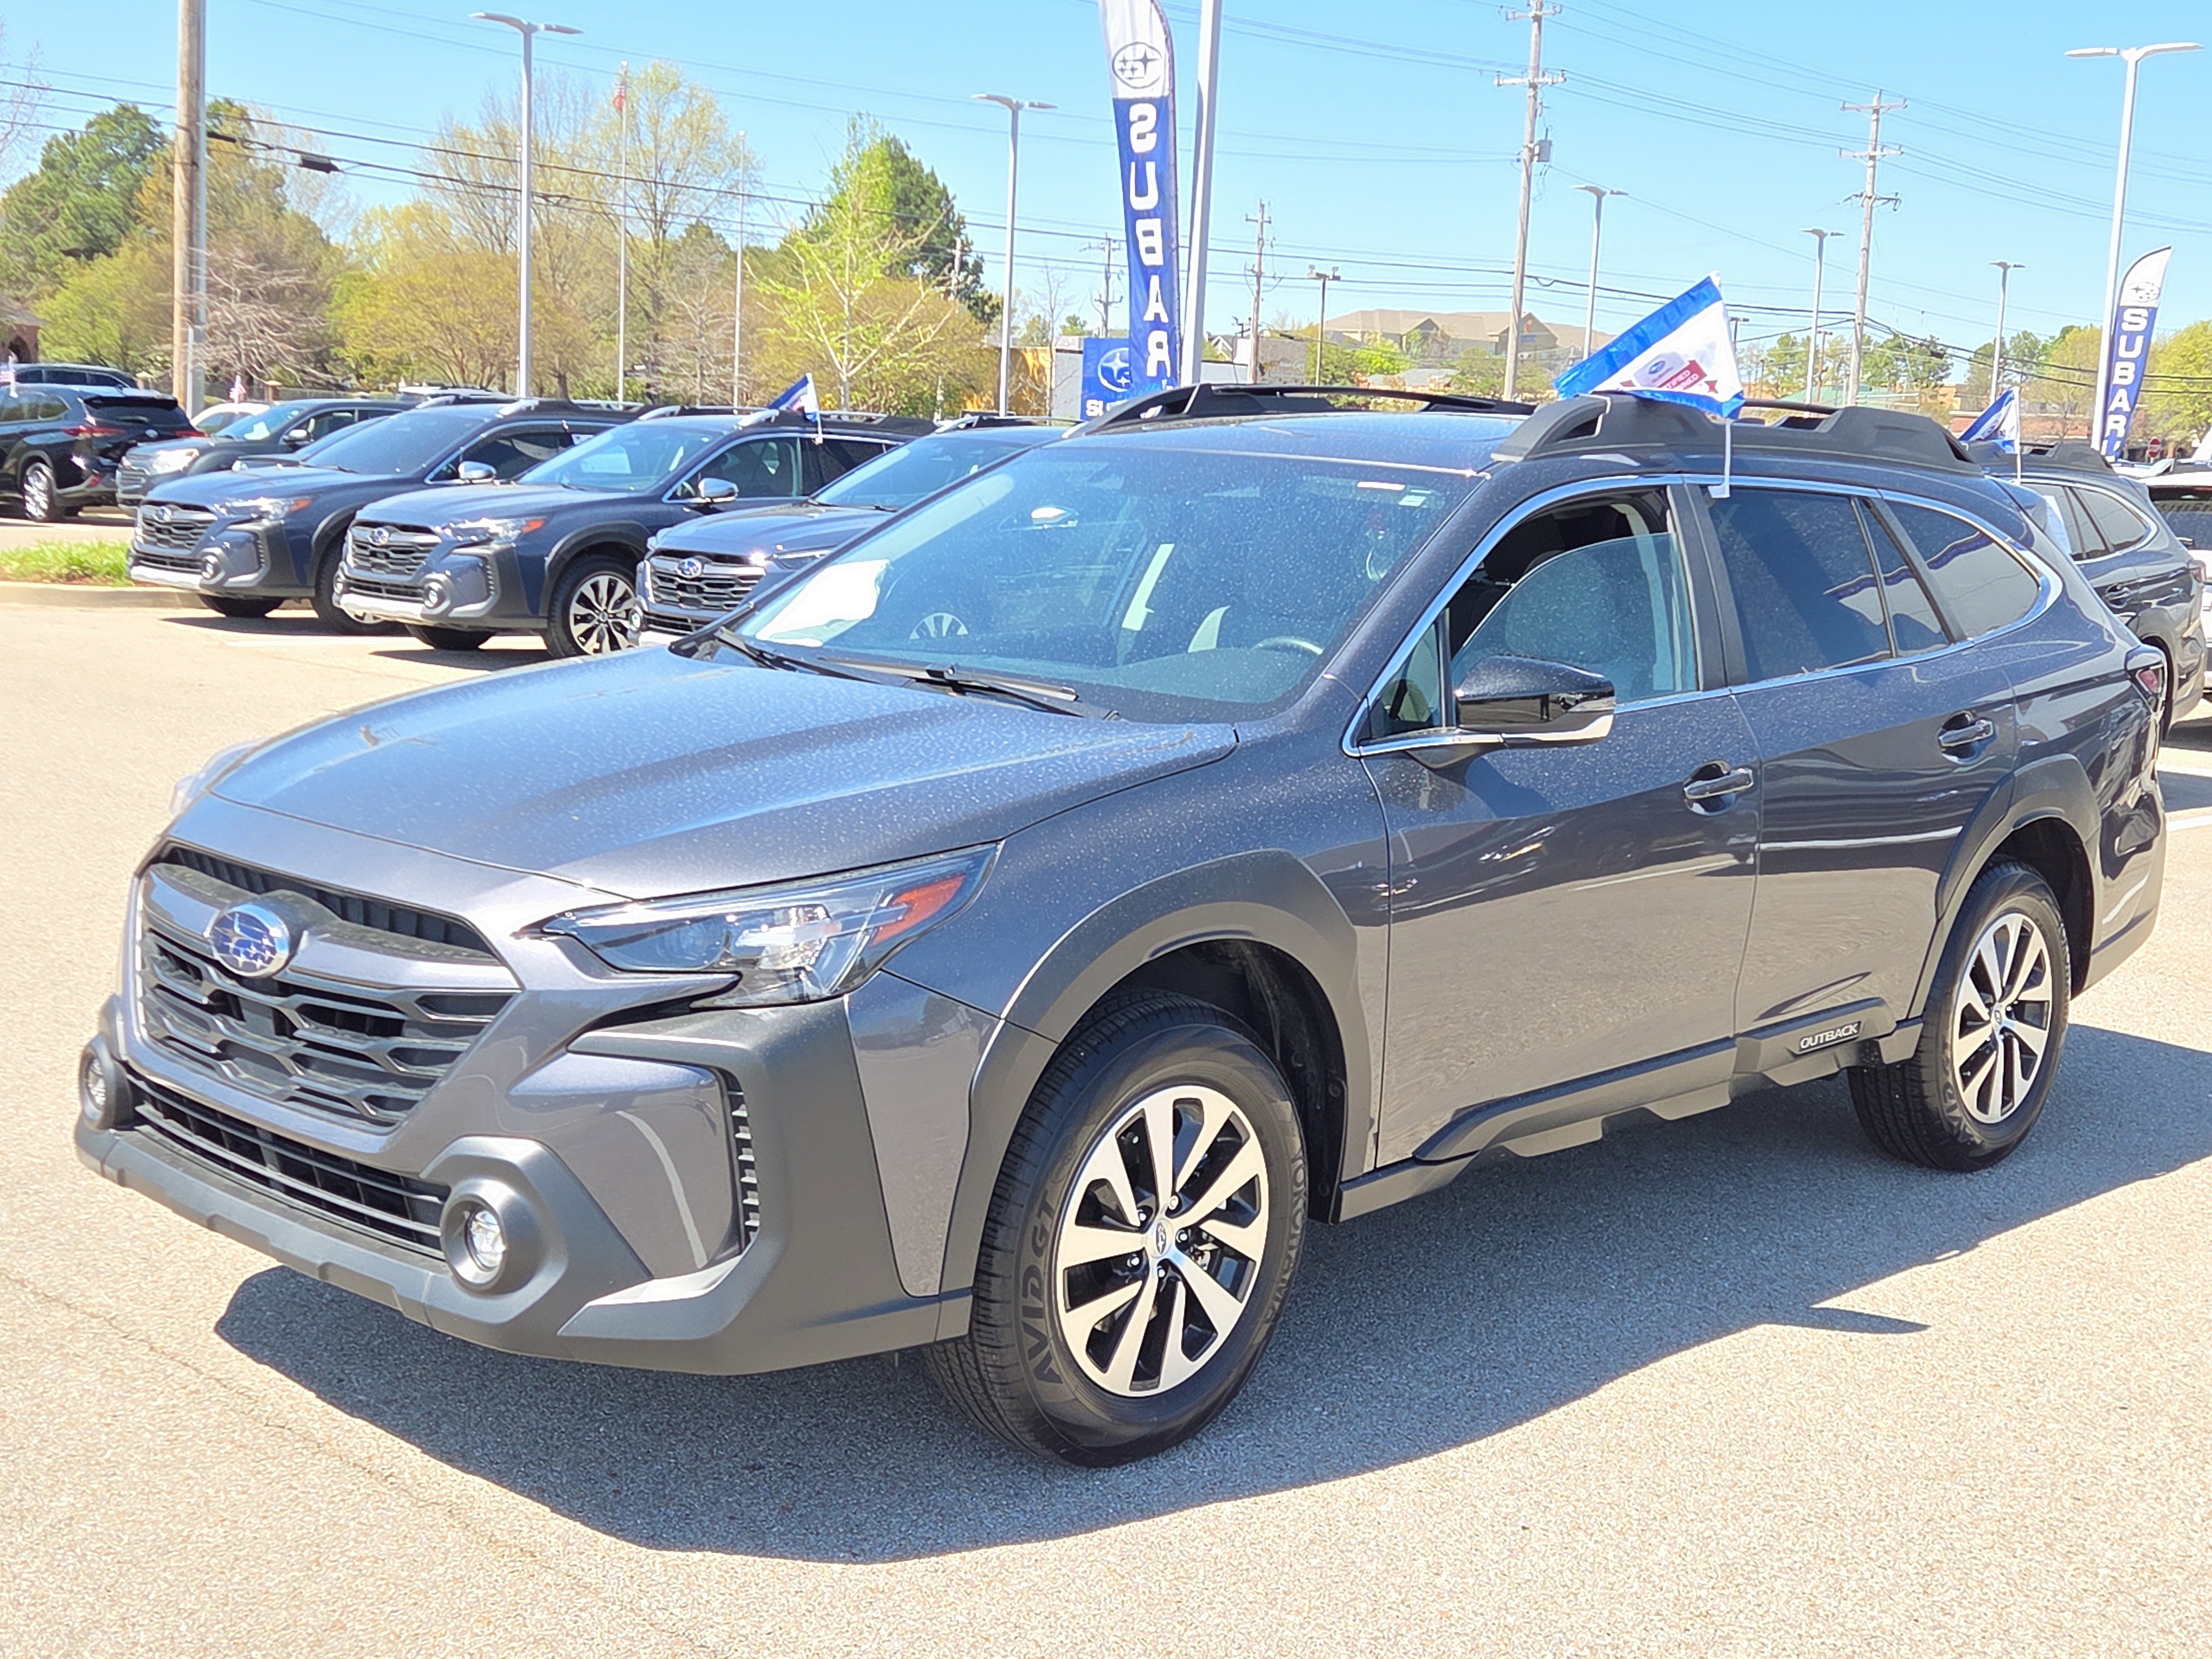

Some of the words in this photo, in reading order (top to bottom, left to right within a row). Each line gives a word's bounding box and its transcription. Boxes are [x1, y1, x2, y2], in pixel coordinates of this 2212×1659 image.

[1800, 1023, 1859, 1049] OUTBACK
[1031, 1189, 1056, 1258] GT
[1022, 1265, 1063, 1384] AVID
